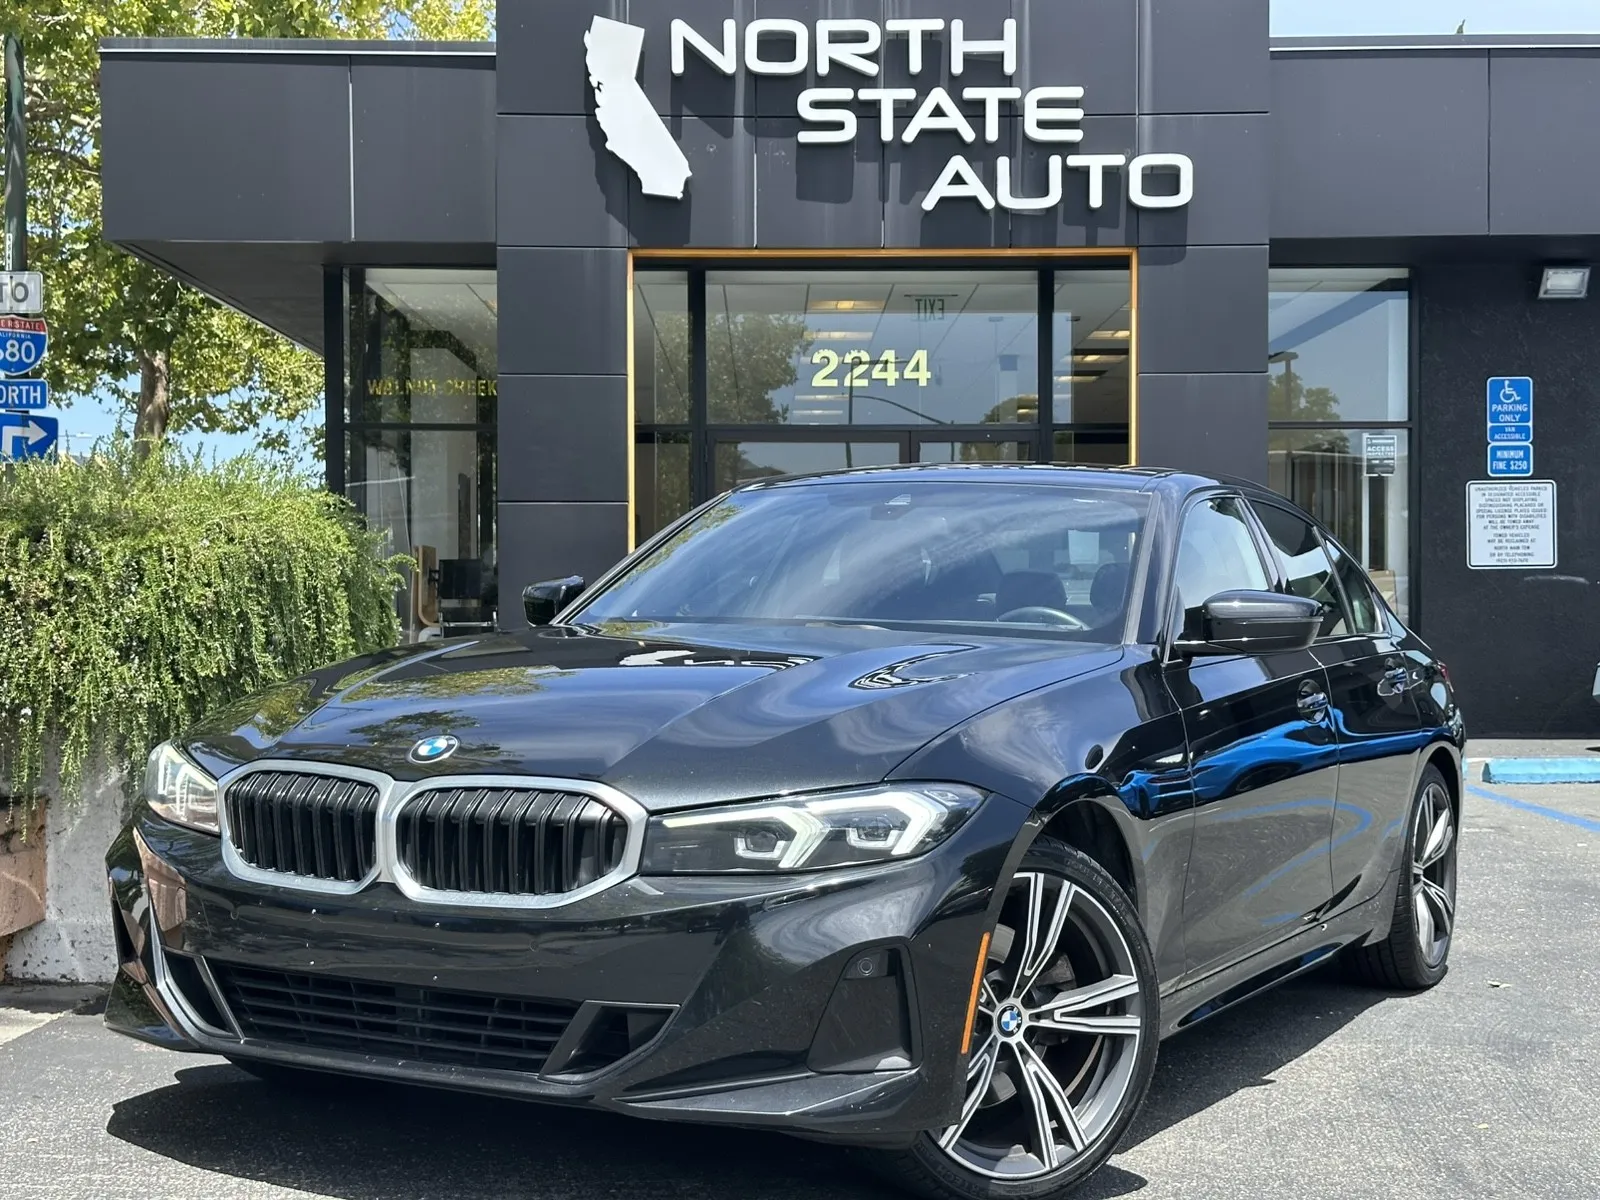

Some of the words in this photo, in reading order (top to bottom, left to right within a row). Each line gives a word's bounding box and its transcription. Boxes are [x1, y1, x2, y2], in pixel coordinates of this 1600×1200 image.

[670, 18, 1017, 77] NORTH
[796, 86, 1085, 144] STATE
[920, 153, 1194, 212] AUTO
[0, 320, 40, 330] ERSTATE
[0, 331, 31, 339] ALIFORNIA
[0, 339, 36, 364] 80
[811, 349, 931, 387] 2244
[0, 385, 41, 405] ORTH
[444, 379, 498, 396] CREEK
[1491, 404, 1528, 412] PARKING
[1498, 414, 1521, 422] ONLY
[1496, 450, 1524, 459] MINIMUM
[1492, 461, 1507, 470] FINE
[1510, 461, 1528, 470] $250
